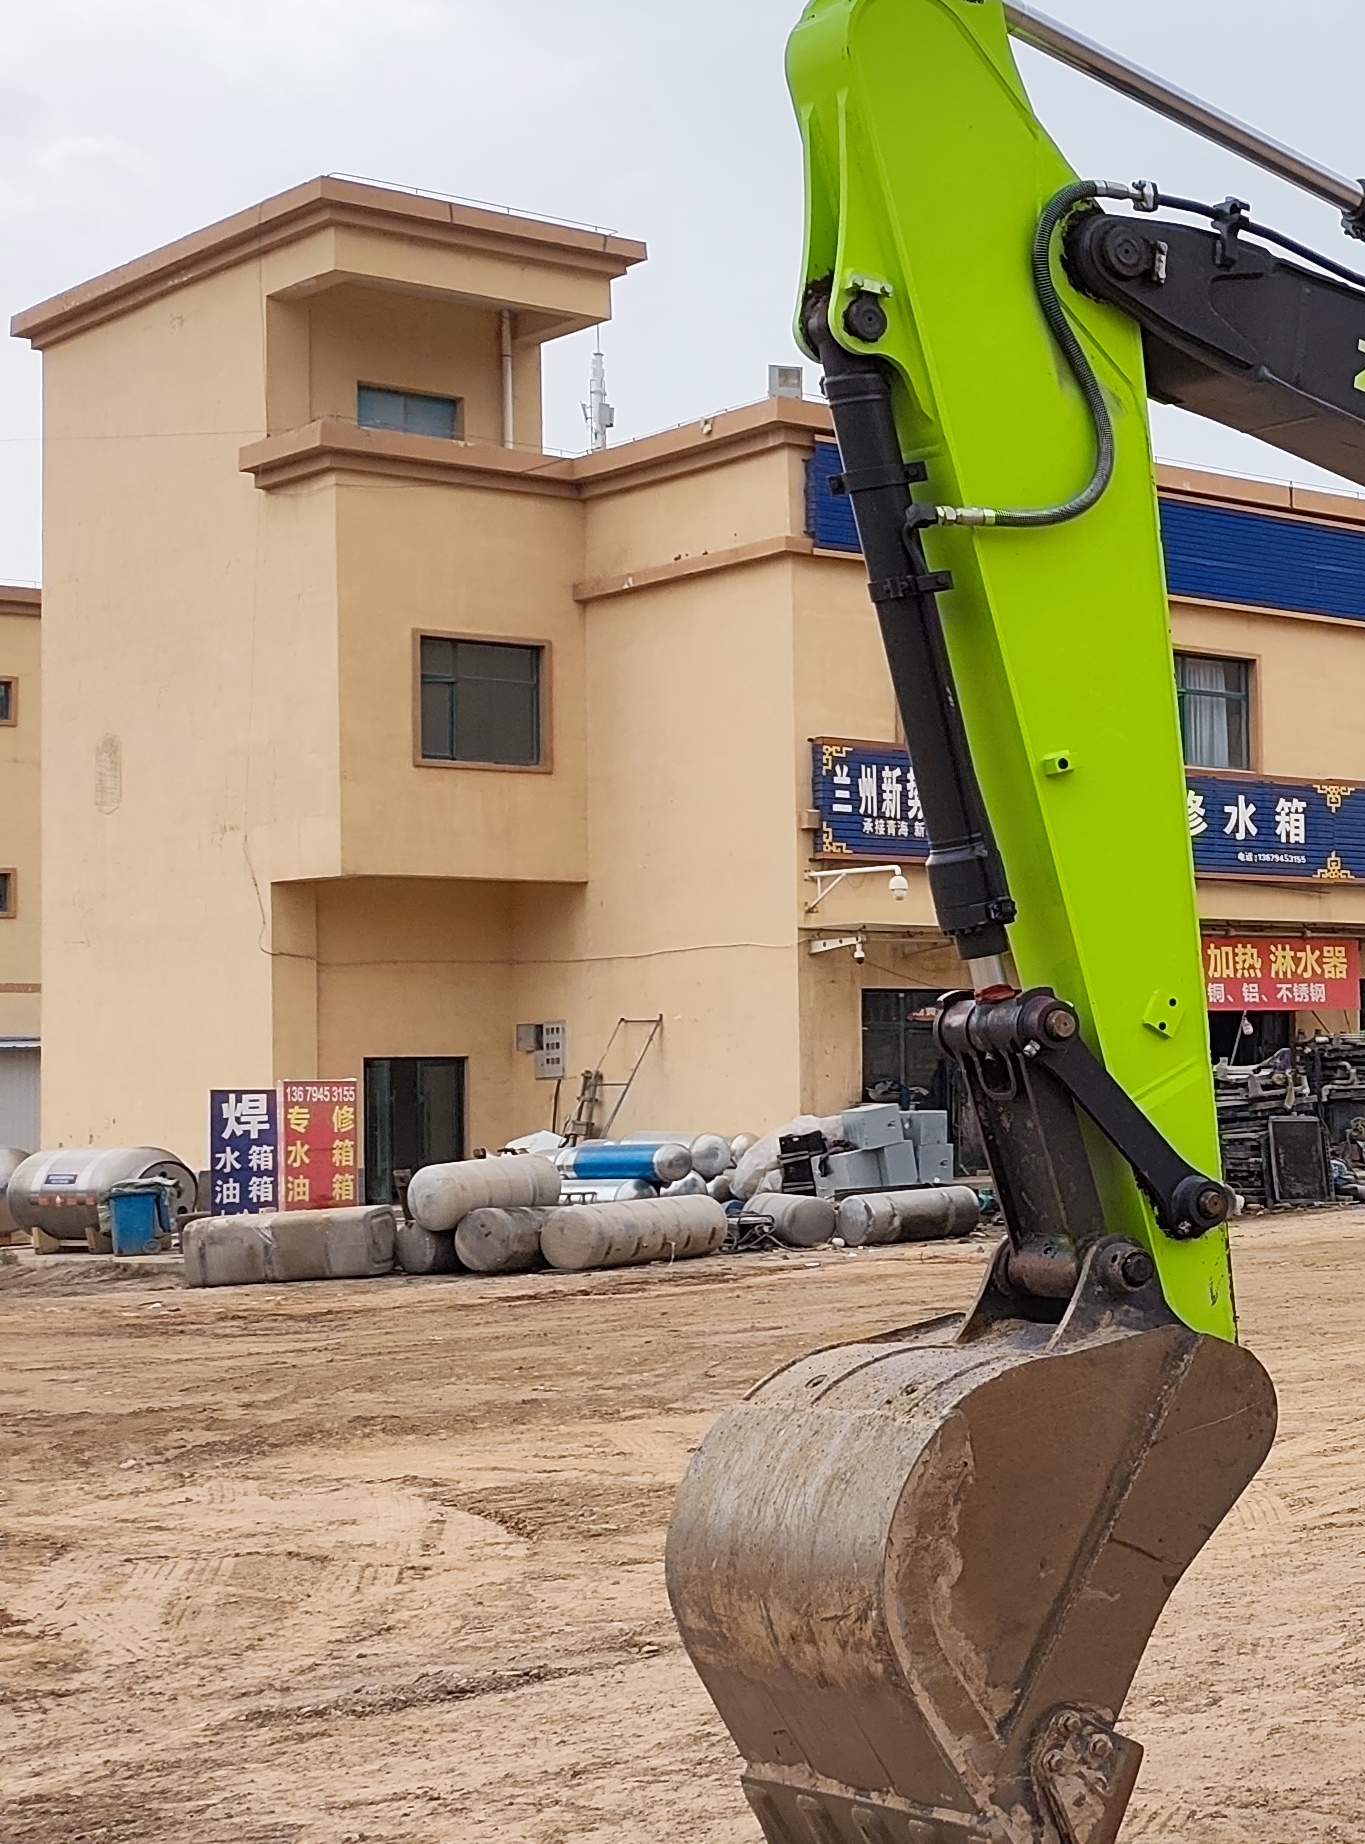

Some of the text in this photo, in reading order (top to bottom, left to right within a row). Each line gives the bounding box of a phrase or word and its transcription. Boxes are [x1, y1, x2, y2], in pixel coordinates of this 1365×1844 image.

[1207, 943, 1348, 979] 加热 淋水器
[1207, 983, 1326, 1003] 铜、铝、不锈钢
[286, 1086, 355, 1102] 136 7945 3155
[221, 1093, 270, 1140] 焊
[287, 1105, 355, 1133] 专修
[215, 1145, 274, 1173] 水箱
[287, 1139, 355, 1168] 水箱
[214, 1175, 274, 1204] 油箱
[287, 1173, 355, 1202] 油箱
